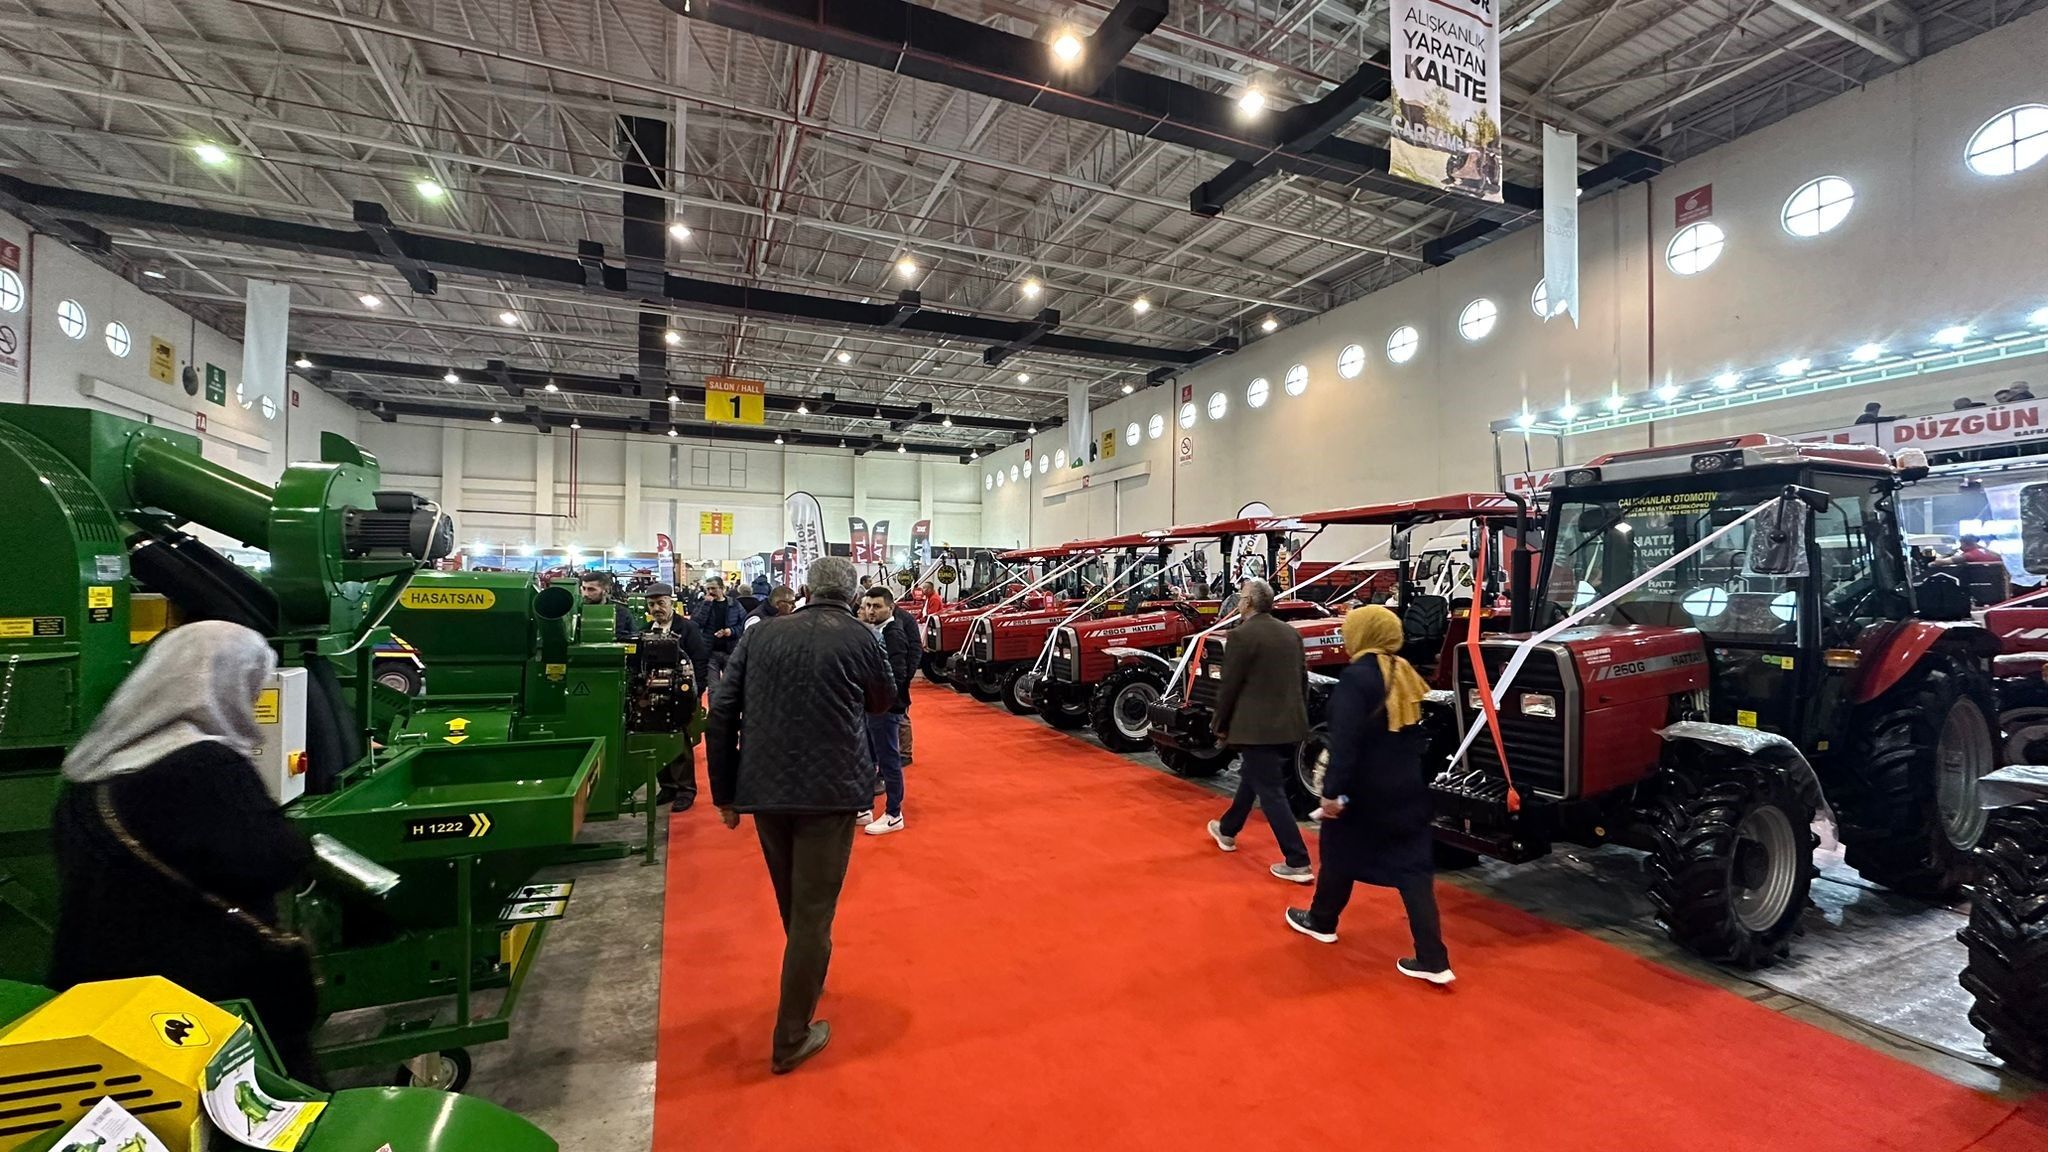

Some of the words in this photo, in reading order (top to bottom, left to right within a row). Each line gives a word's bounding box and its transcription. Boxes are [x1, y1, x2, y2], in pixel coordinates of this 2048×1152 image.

[1404, 7, 1485, 53] ALIŞKANLIK
[1403, 29, 1486, 77] YARATAN
[709, 381, 735, 391] SALON
[741, 384, 760, 393] HALL
[730, 395, 740, 418] 1
[1893, 406, 2039, 443] DÜZGÜN
[730, 572, 737, 581] 2
[411, 593, 484, 604] HASATSAN
[1132, 624, 1157, 632] HATTAT
[1320, 636, 1344, 645] HATTA
[413, 825, 424, 835] H
[429, 822, 463, 834] 1222
